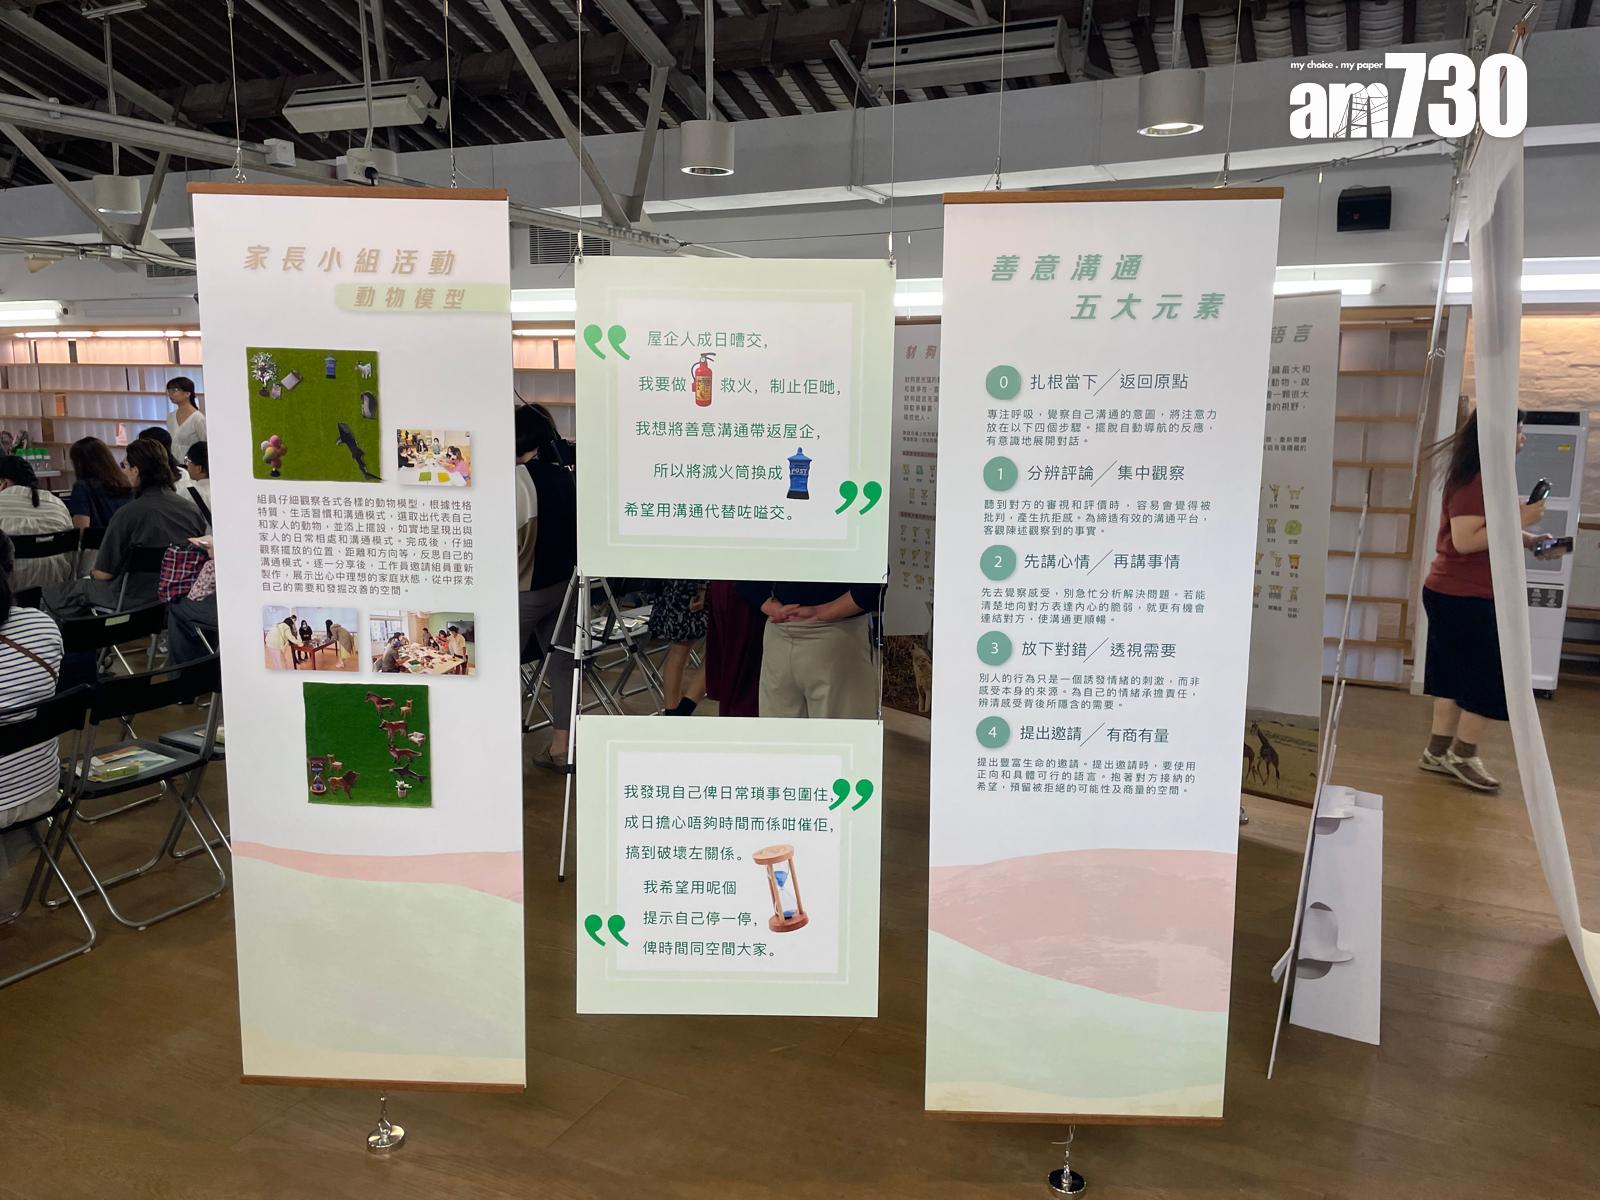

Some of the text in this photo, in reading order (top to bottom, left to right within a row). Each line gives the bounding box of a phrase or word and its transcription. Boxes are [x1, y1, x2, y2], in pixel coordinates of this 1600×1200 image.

[243, 245, 455, 277] 家長小組活動
[992, 254, 1143, 281] 善意溝通
[354, 286, 465, 309] 動物模型
[1070, 293, 1225, 320] 五大元素
[639, 376, 686, 391] 我要做
[999, 375, 1009, 389] 0
[987, 408, 1216, 421] 專注呼吸，覺察自己溝通的意圖，將注意力
[636, 421, 820, 440] 我想將善意溝通帶返屋企，
[987, 422, 1212, 434] 放在以下四個步驟。擺脫自動導航的反應，
[987, 435, 1088, 447] 有意識地展開對話。
[654, 463, 782, 480] 所以將滅火筒換成
[996, 467, 1005, 482] 1
[624, 502, 792, 520] 希望用溝通代替咗嗌交。
[984, 525, 1104, 536] 客觀陳述觀察到的事實。
[993, 555, 1004, 568] 2
[990, 642, 1000, 655] 3
[987, 726, 998, 739] 4
[624, 815, 833, 832] 成日擔心唔夠時間而係咁催佢，
[625, 845, 741, 863] 搞到破壞左關係。
[644, 880, 736, 895] 我希望用呢個
[643, 911, 757, 926] 提示自己停一停，
[643, 941, 776, 956] 俾時間同空間大家。
